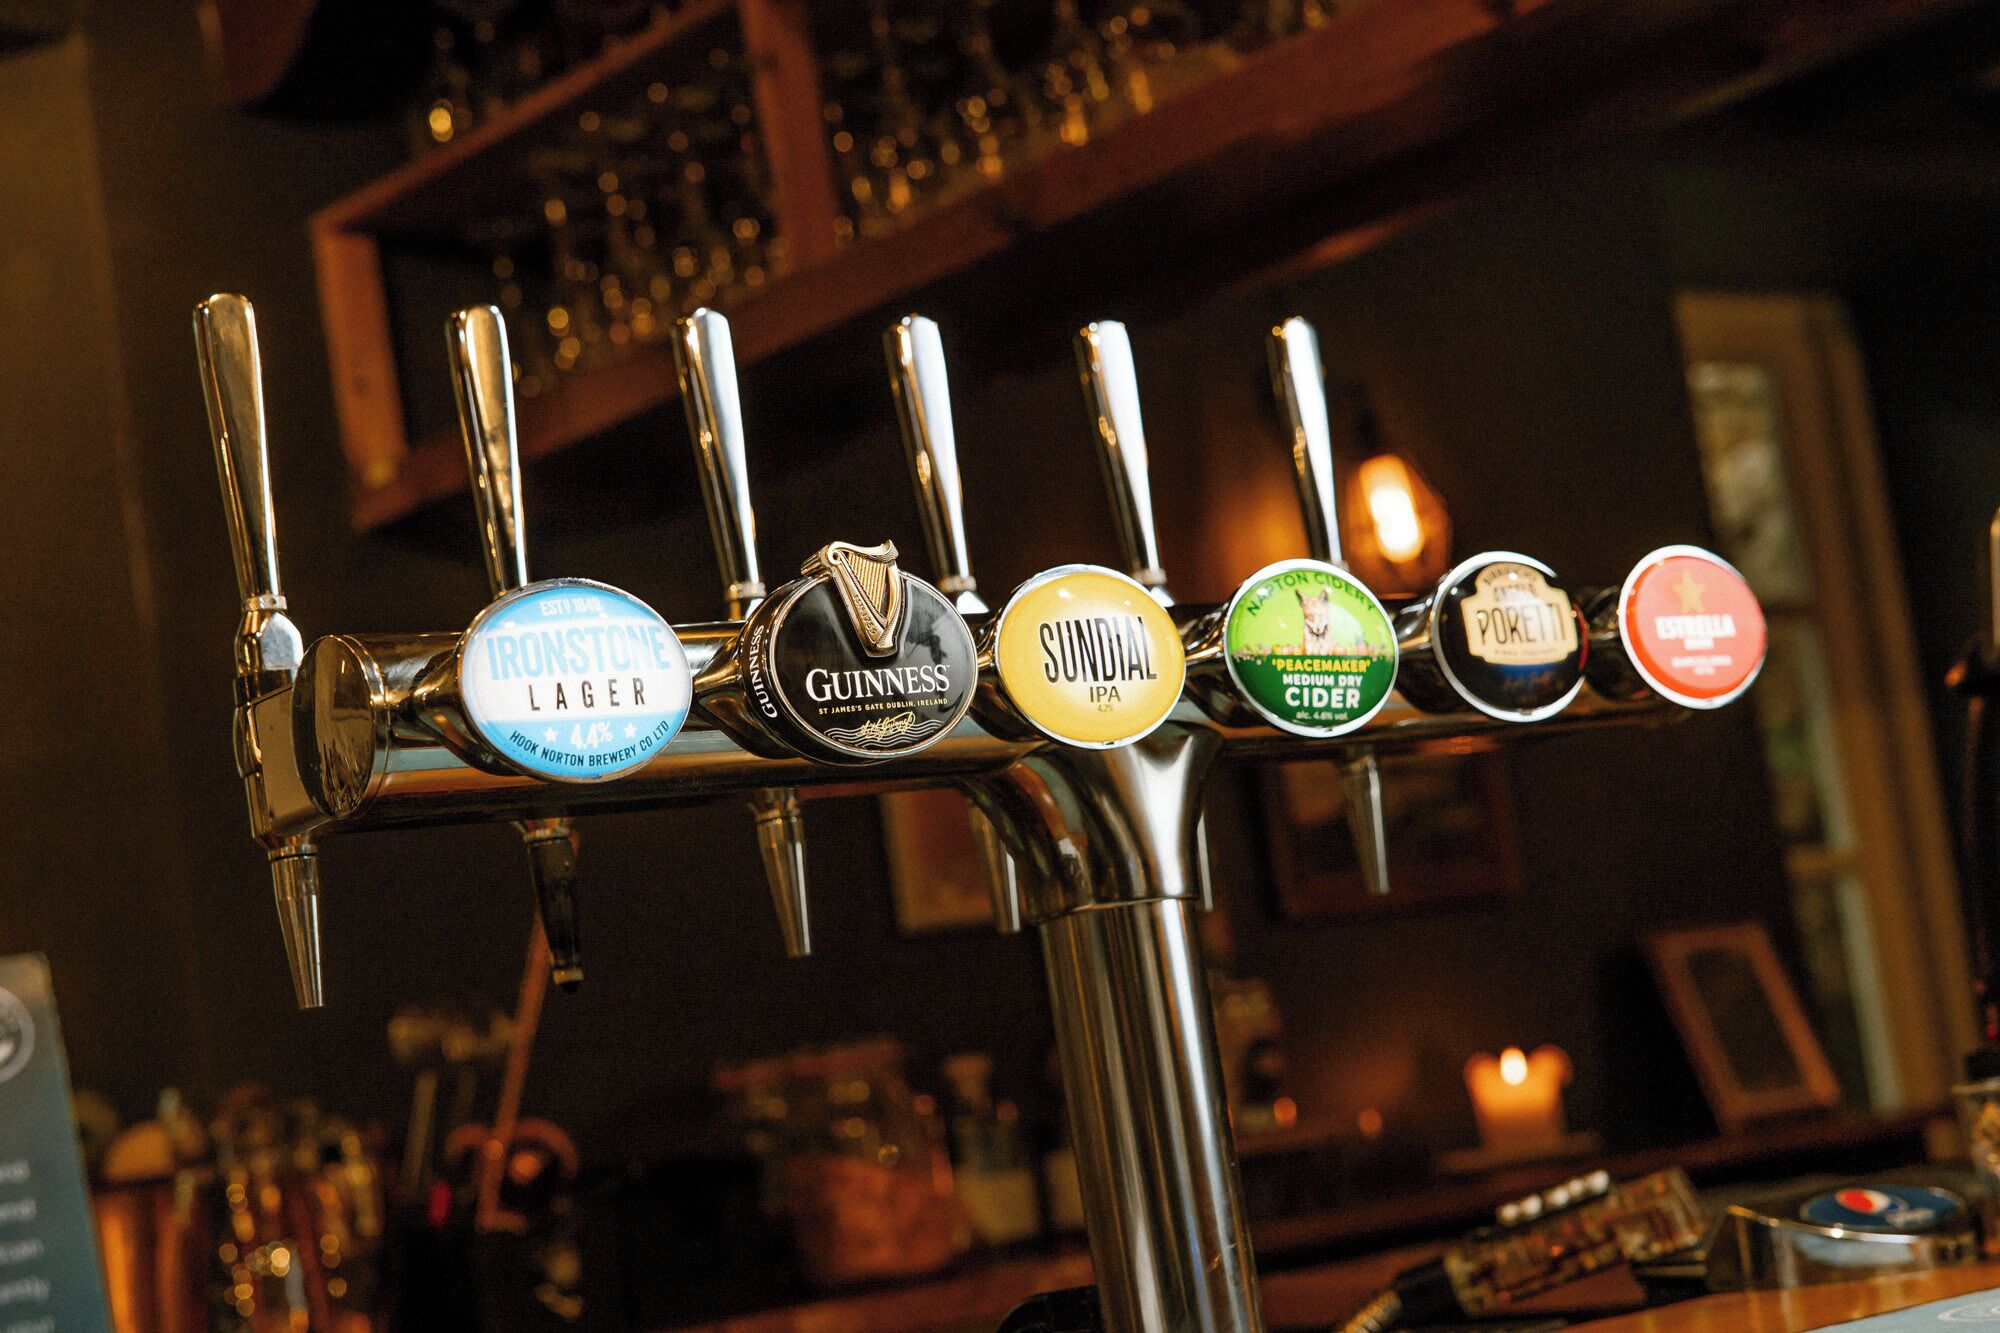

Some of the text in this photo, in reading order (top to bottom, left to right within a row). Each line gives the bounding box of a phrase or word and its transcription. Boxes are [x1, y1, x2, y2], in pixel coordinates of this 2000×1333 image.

[1476, 603, 1567, 645] PORETTI
[486, 624, 672, 681] IRONSTONE
[1039, 616, 1157, 683] SUNDIAL
[748, 624, 778, 719] GUINNESS
[805, 664, 950, 702] GUINNESS
[1282, 673, 1363, 687] MEDIUM DRY
[528, 677, 646, 712] LAGER
[831, 704, 862, 714] JAMES'S
[865, 703, 884, 711] GATE
[886, 701, 916, 709] DUBLIN,
[917, 698, 948, 707] IRELAND
[1090, 686, 1121, 703] IPA
[1285, 686, 1361, 709] CIDER
[509, 720, 670, 767] HOOK NORTON BREWERY CO LTD
[569, 721, 613, 749] 4.4%
